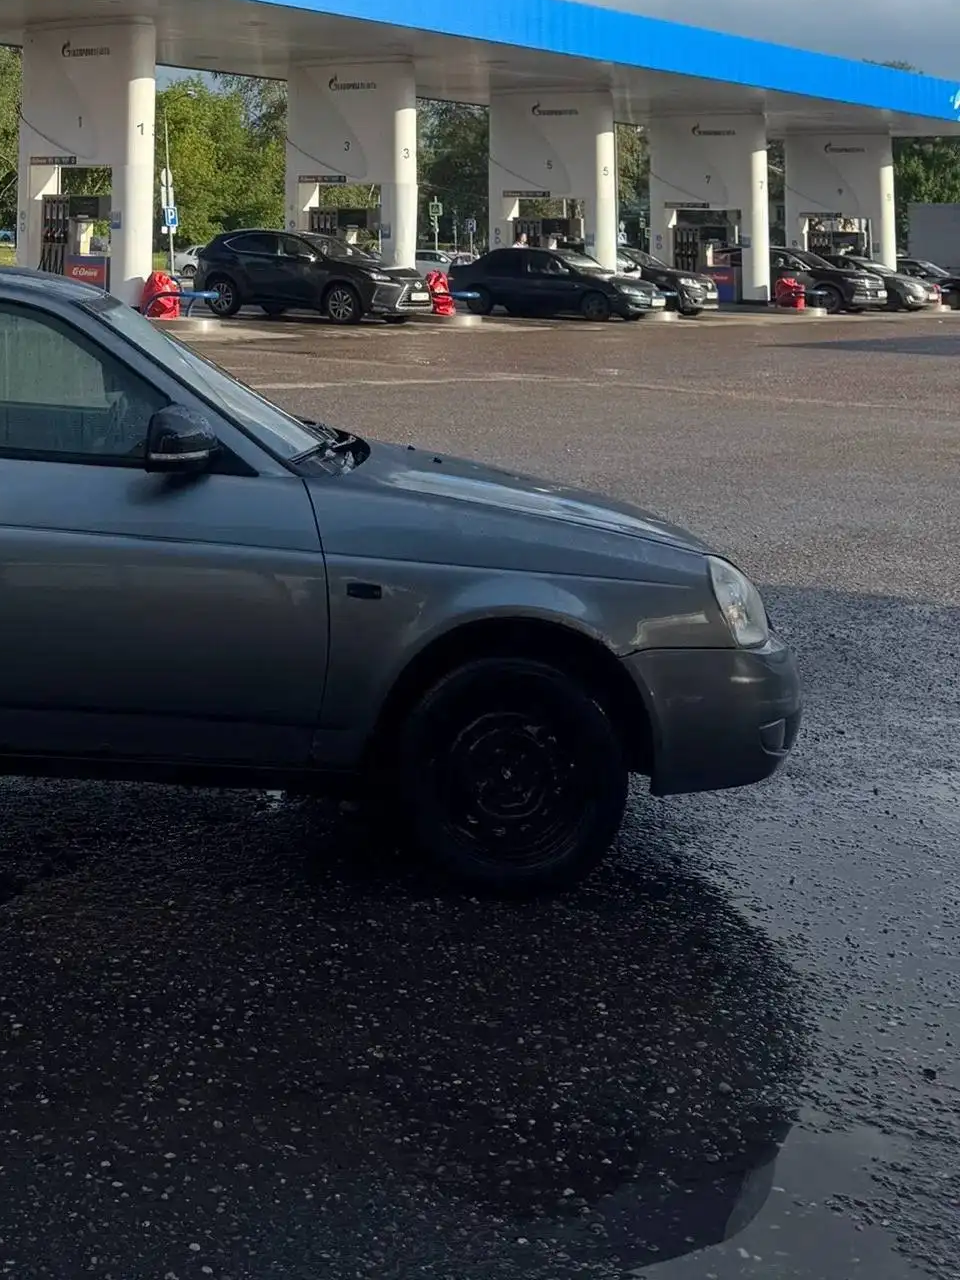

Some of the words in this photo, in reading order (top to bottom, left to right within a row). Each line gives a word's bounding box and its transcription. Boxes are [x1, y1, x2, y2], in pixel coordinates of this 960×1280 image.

[344, 141, 351, 152] 3
[403, 148, 410, 159] 3
[546, 159, 553, 170] 5
[603, 166, 609, 176] 5
[705, 175, 711, 184] 7
[168, 209, 175, 224] P
